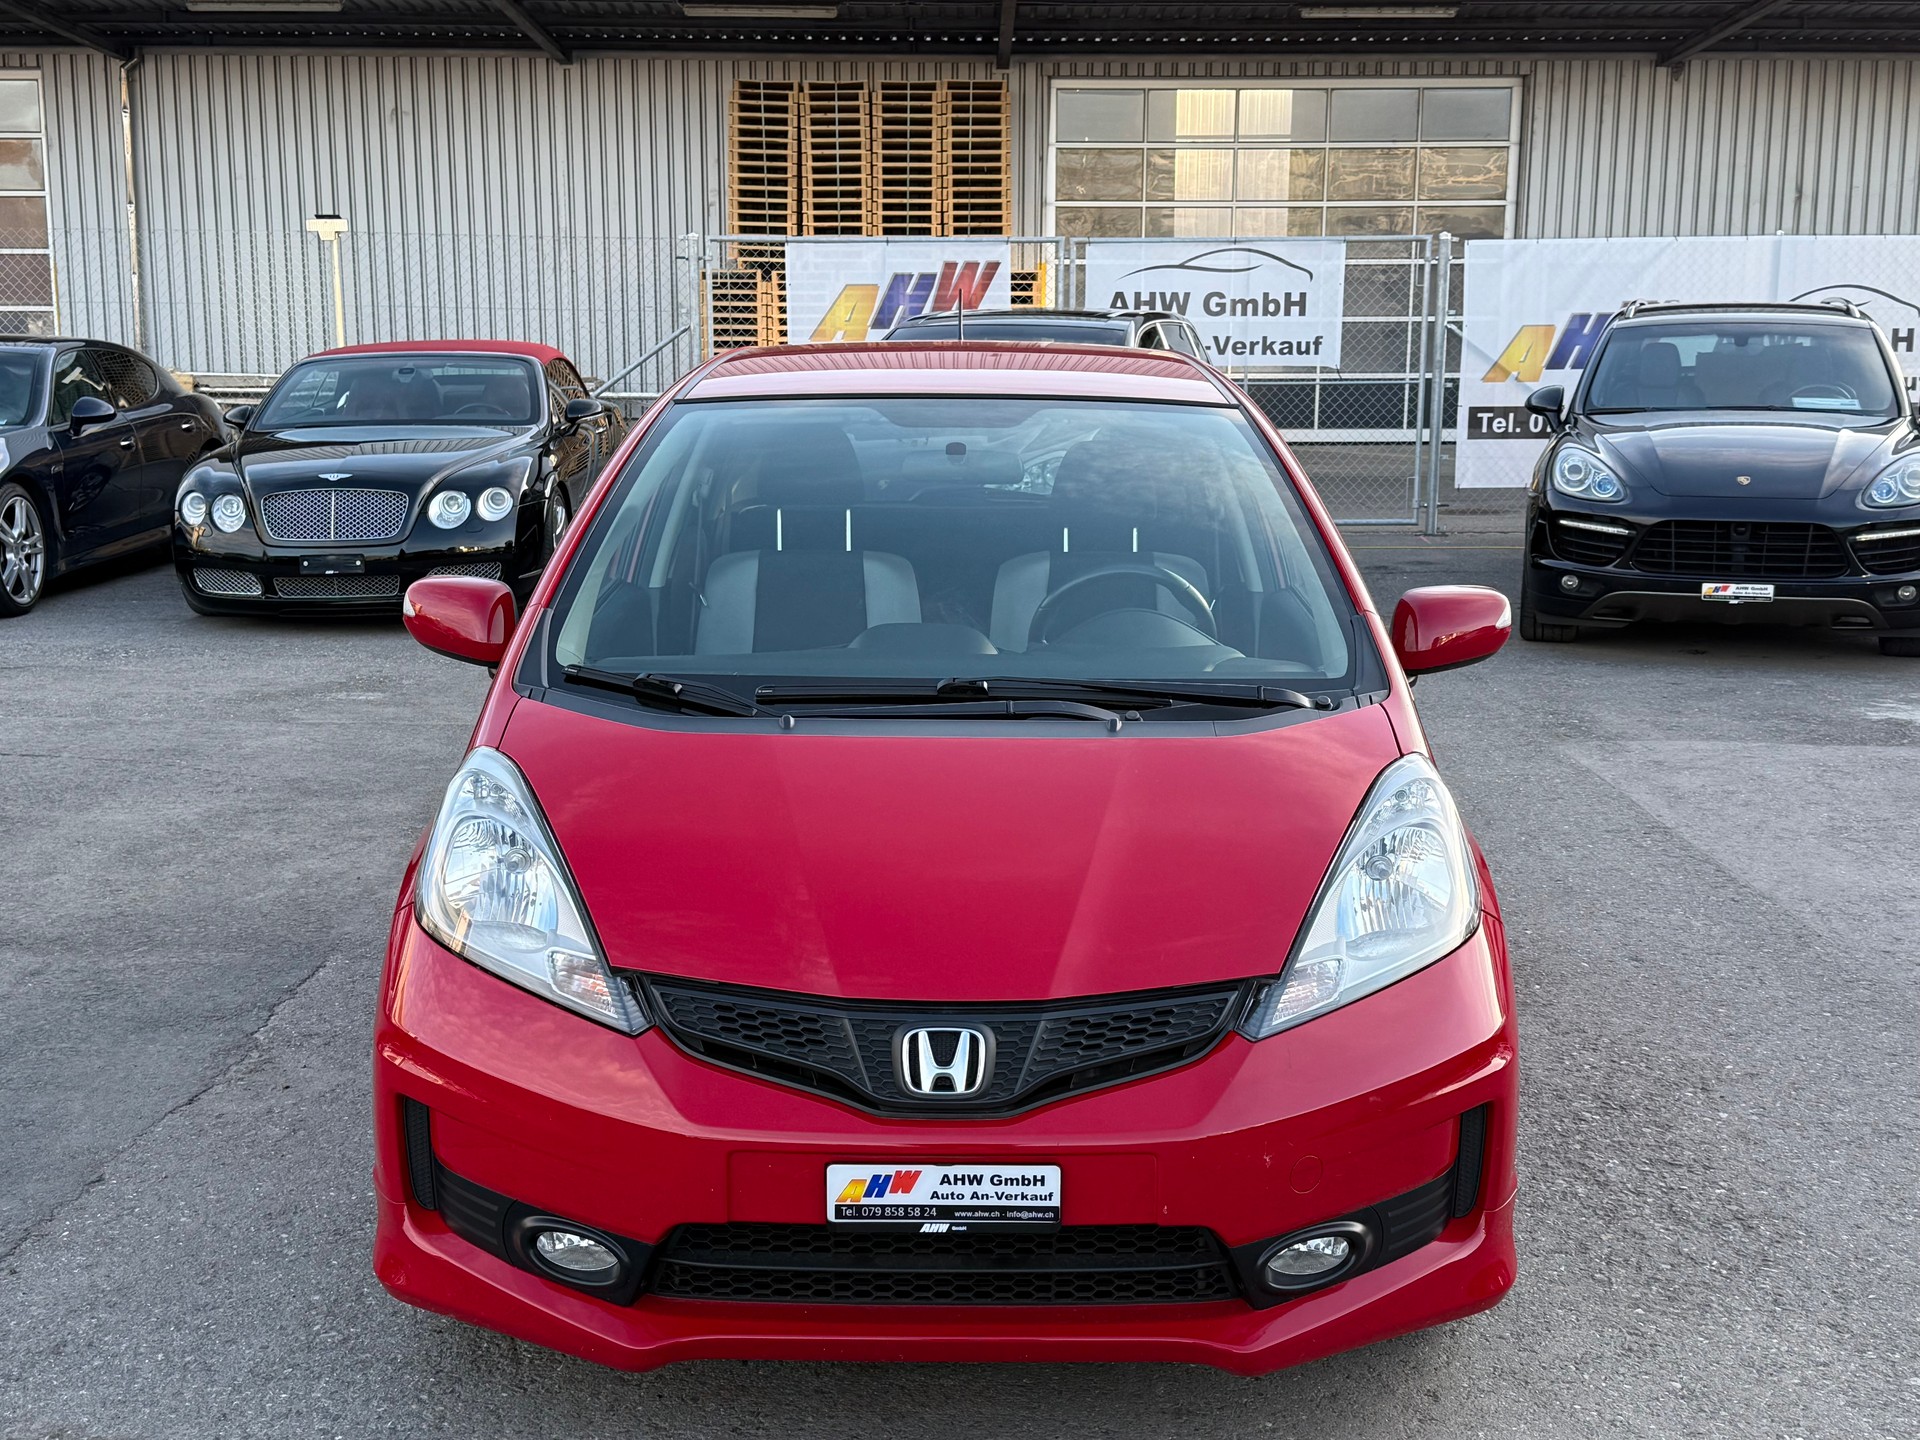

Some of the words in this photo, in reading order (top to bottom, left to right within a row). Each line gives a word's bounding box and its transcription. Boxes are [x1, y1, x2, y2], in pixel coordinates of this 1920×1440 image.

[808, 260, 1002, 342] AHW
[1109, 290, 1191, 317] AHW
[1203, 290, 1307, 317] GmbH
[1477, 412, 1521, 433] Tel.
[939, 1174, 984, 1186] AHW
[990, 1174, 1045, 1186] GmbH
[835, 1170, 922, 1203] AHW
[930, 1190, 965, 1200] Auto
[970, 1191, 1054, 1201] An-Verkauf
[841, 1207, 858, 1217] Tel.
[862, 1206, 881, 1217] 079
[885, 1206, 905, 1217] 858
[907, 1206, 920, 1217] 58
[924, 1206, 937, 1217] 24
[954, 1210, 1000, 1218] www.ahw.ch
[1006, 1210, 1054, 1219] info@ahw.ch
[920, 1223, 950, 1232] AHW
